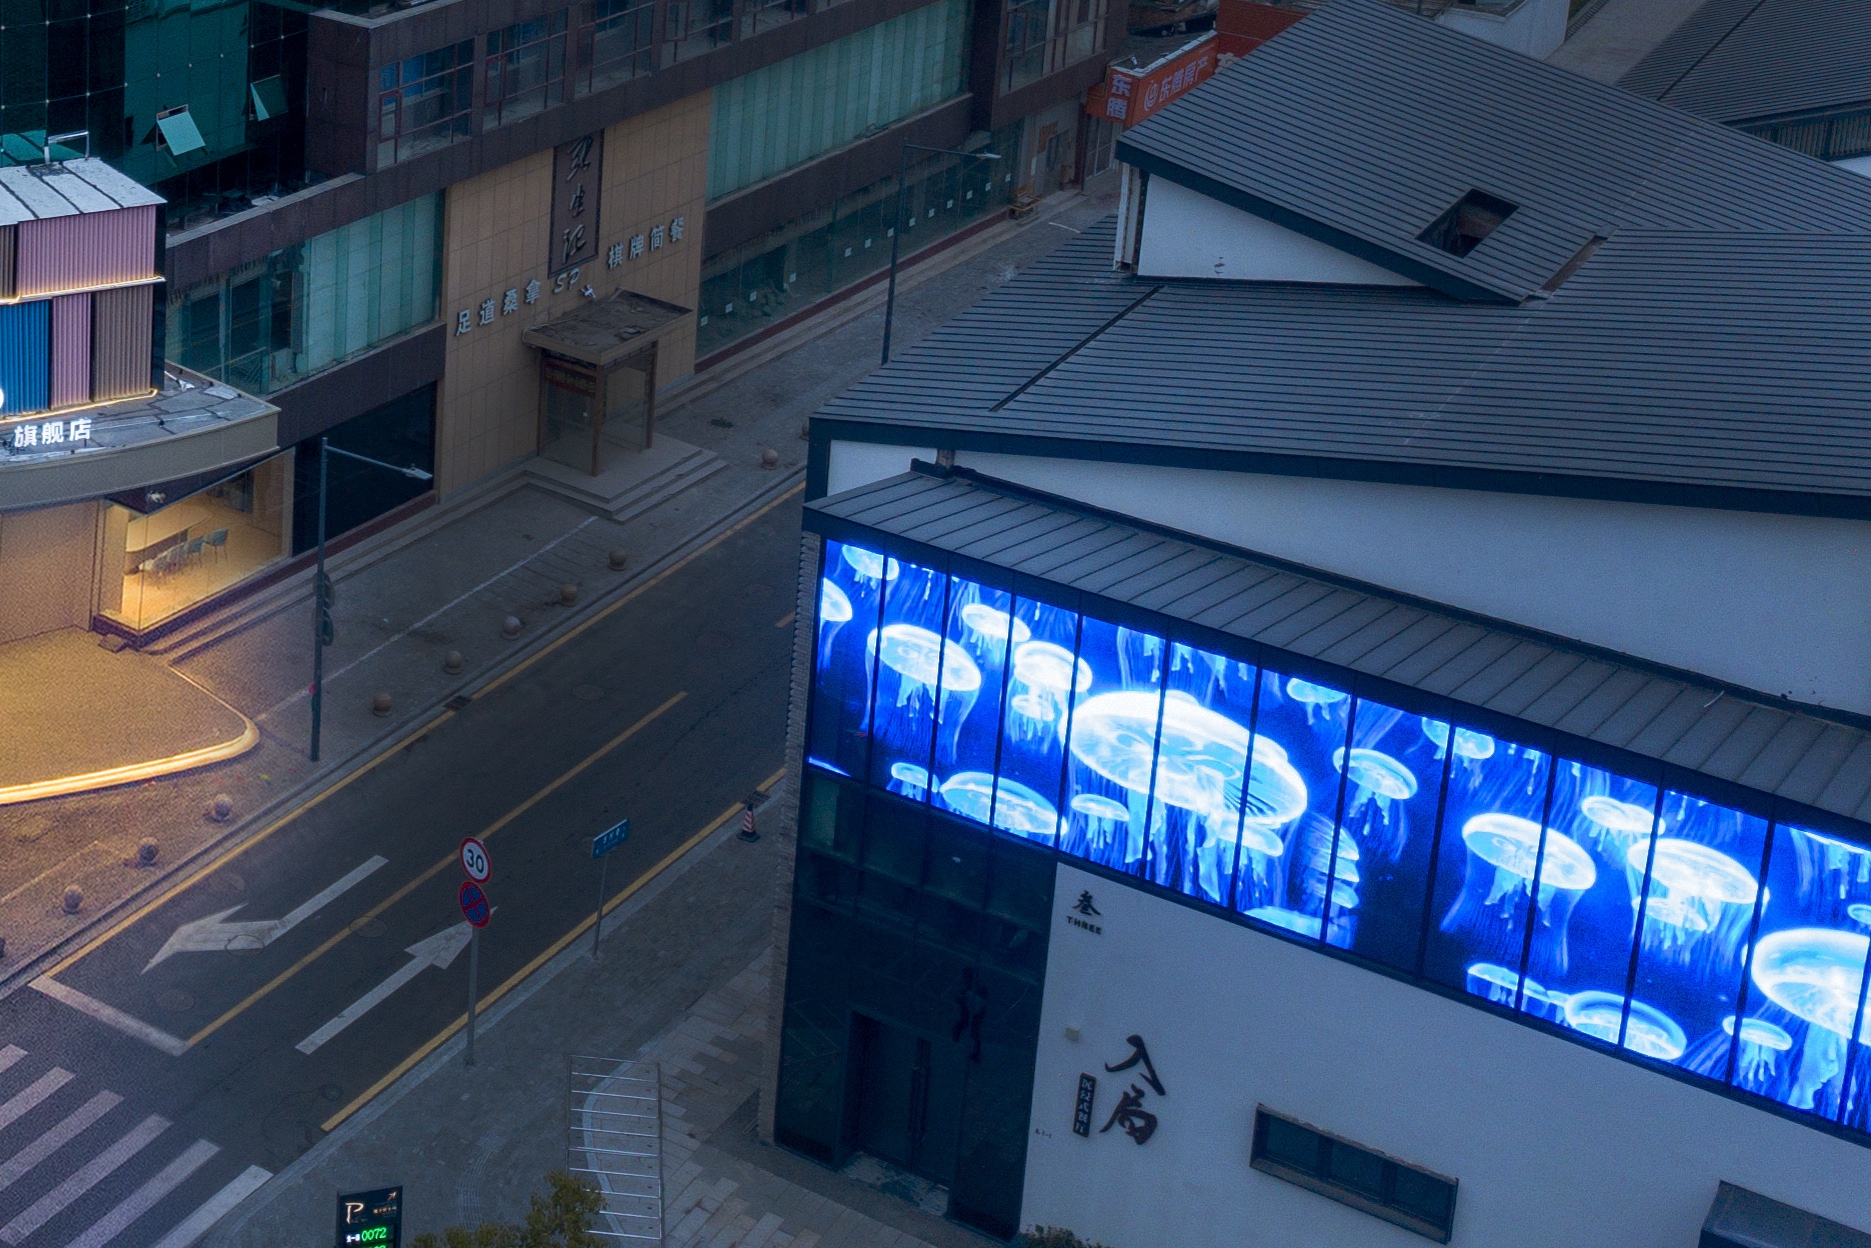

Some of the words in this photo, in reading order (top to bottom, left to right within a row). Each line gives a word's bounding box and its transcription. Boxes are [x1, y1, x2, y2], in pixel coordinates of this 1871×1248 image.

[1106, 74, 1132, 120] 东腾
[1158, 55, 1209, 103] 东腾房产
[455, 278, 542, 337] 足道桑拿
[607, 216, 685, 270] 棋牌简餐
[13, 417, 92, 449] 旗舰店
[465, 848, 486, 875] 30
[1065, 915, 1103, 936] THREE
[1099, 1035, 1166, 1145] 入局
[361, 1227, 387, 1242] 0072
